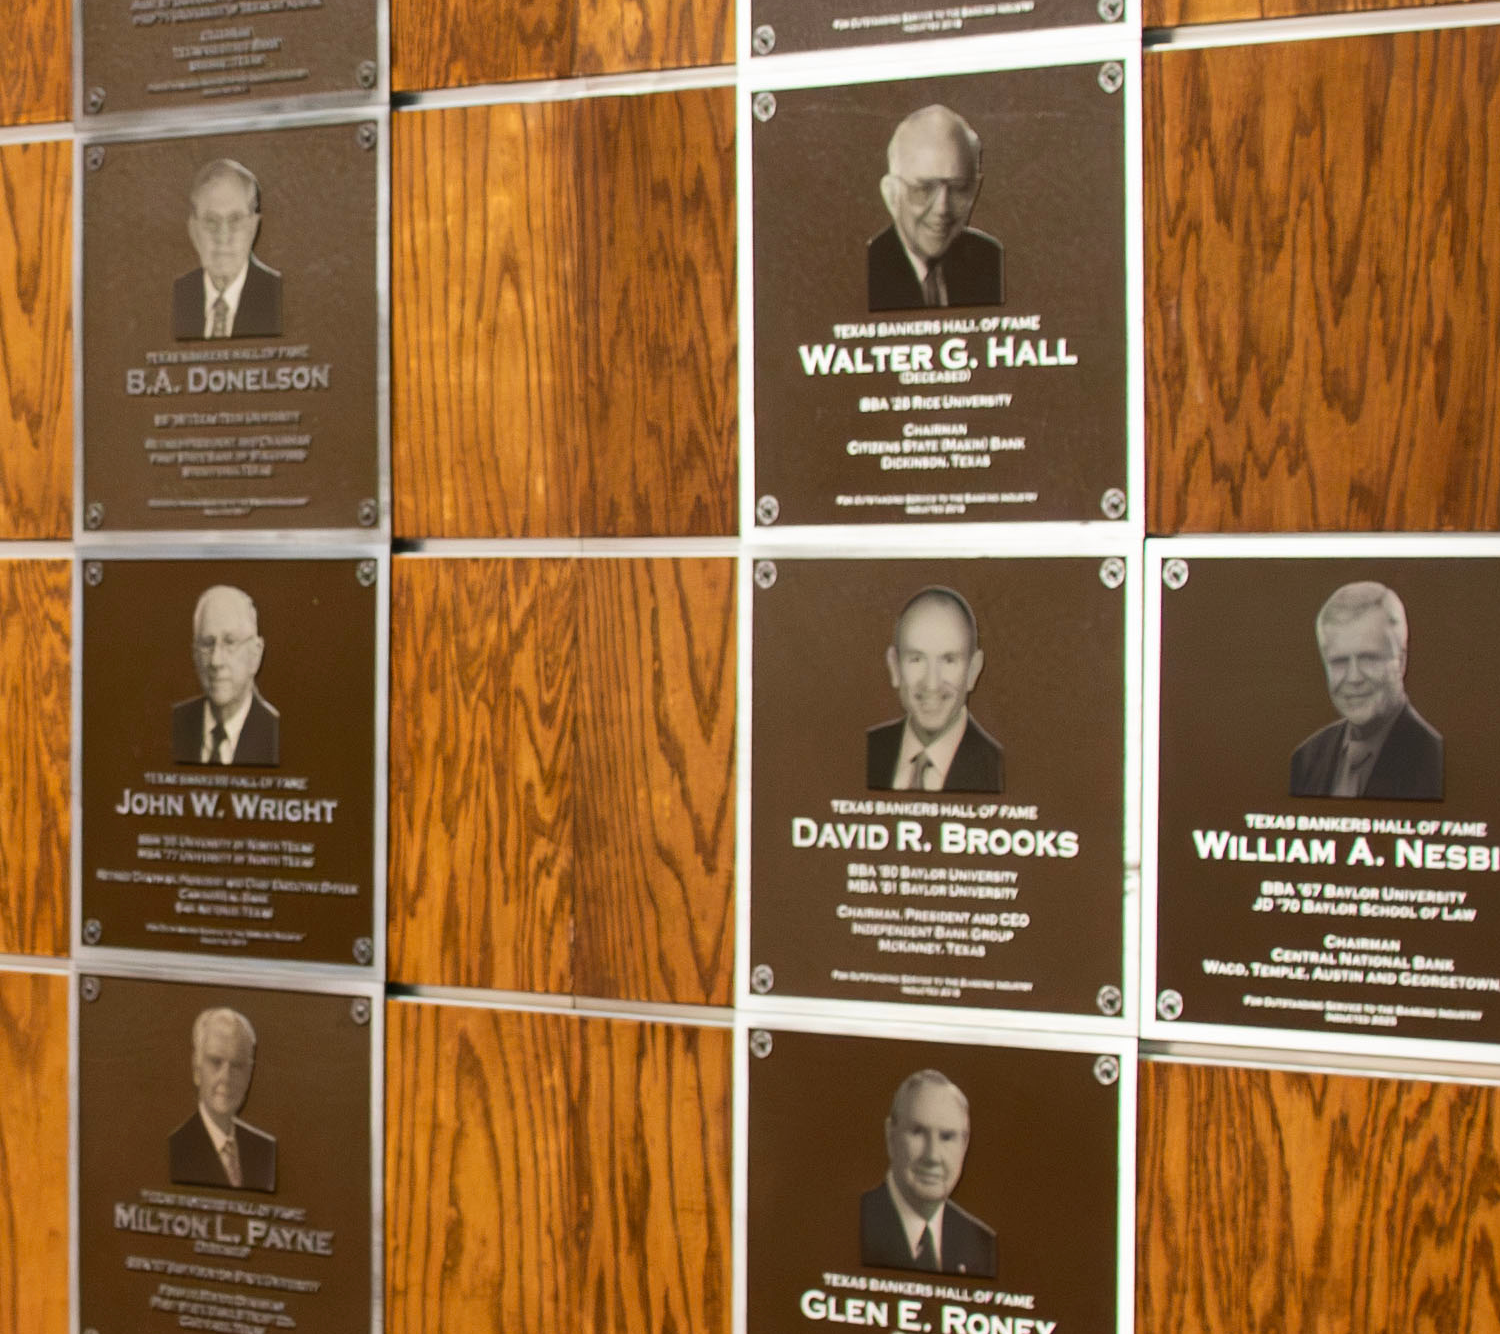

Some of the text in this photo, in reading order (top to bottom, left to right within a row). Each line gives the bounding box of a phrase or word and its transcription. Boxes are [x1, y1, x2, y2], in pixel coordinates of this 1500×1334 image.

[798, 336, 1078, 375] WALTER G. HALL
[791, 816, 1079, 858] DAVID R. BROOKS
[1191, 829, 1336, 864] WILLIAM
[1346, 836, 1384, 867] A.
[800, 1289, 888, 1327] GLEN
[897, 1299, 932, 1332] E.
